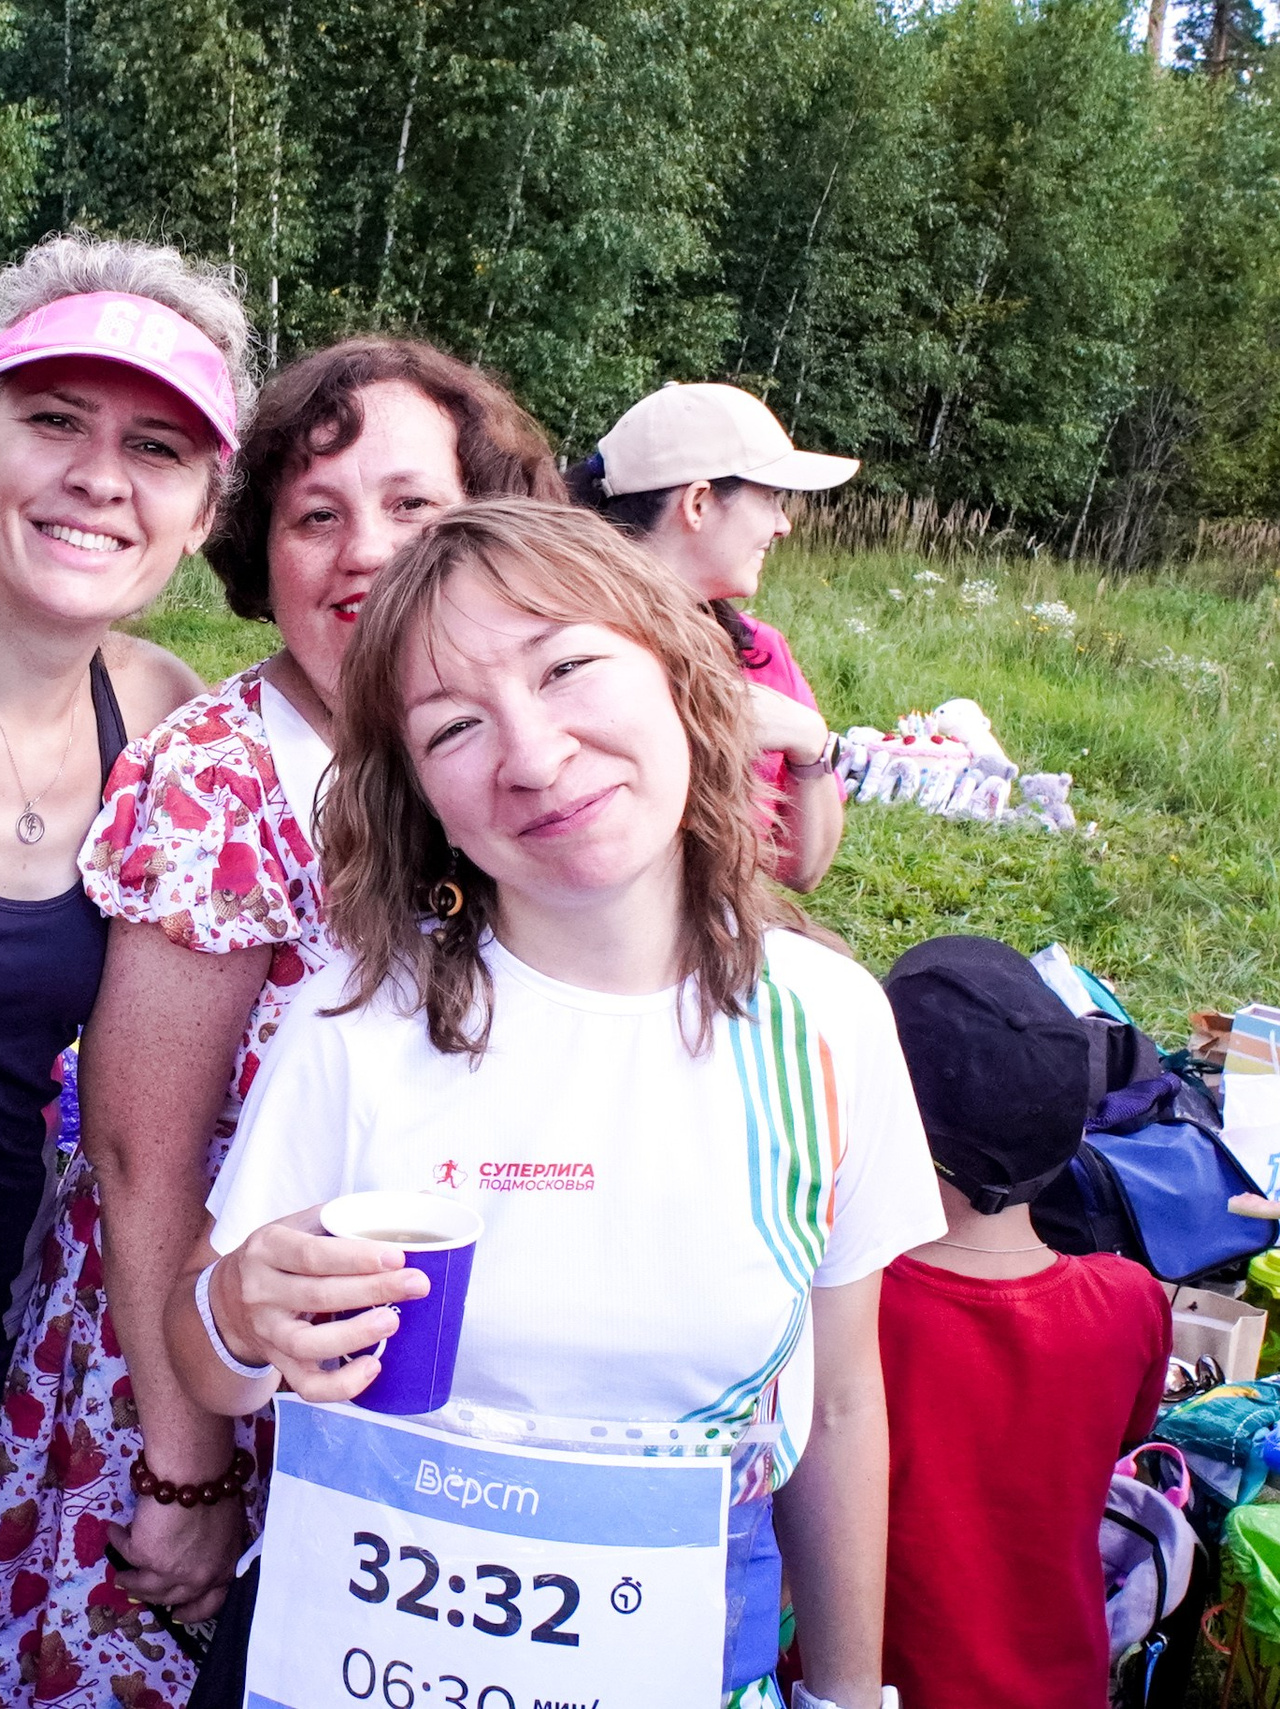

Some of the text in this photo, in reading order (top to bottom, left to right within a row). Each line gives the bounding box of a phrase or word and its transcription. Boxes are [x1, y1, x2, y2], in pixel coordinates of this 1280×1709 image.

[478, 1162, 595, 1177] СУПЕРЛИГА
[478, 1178, 595, 1192] ПОДМОСКОВЬЯ
[348, 1531, 581, 1647] 32:32
